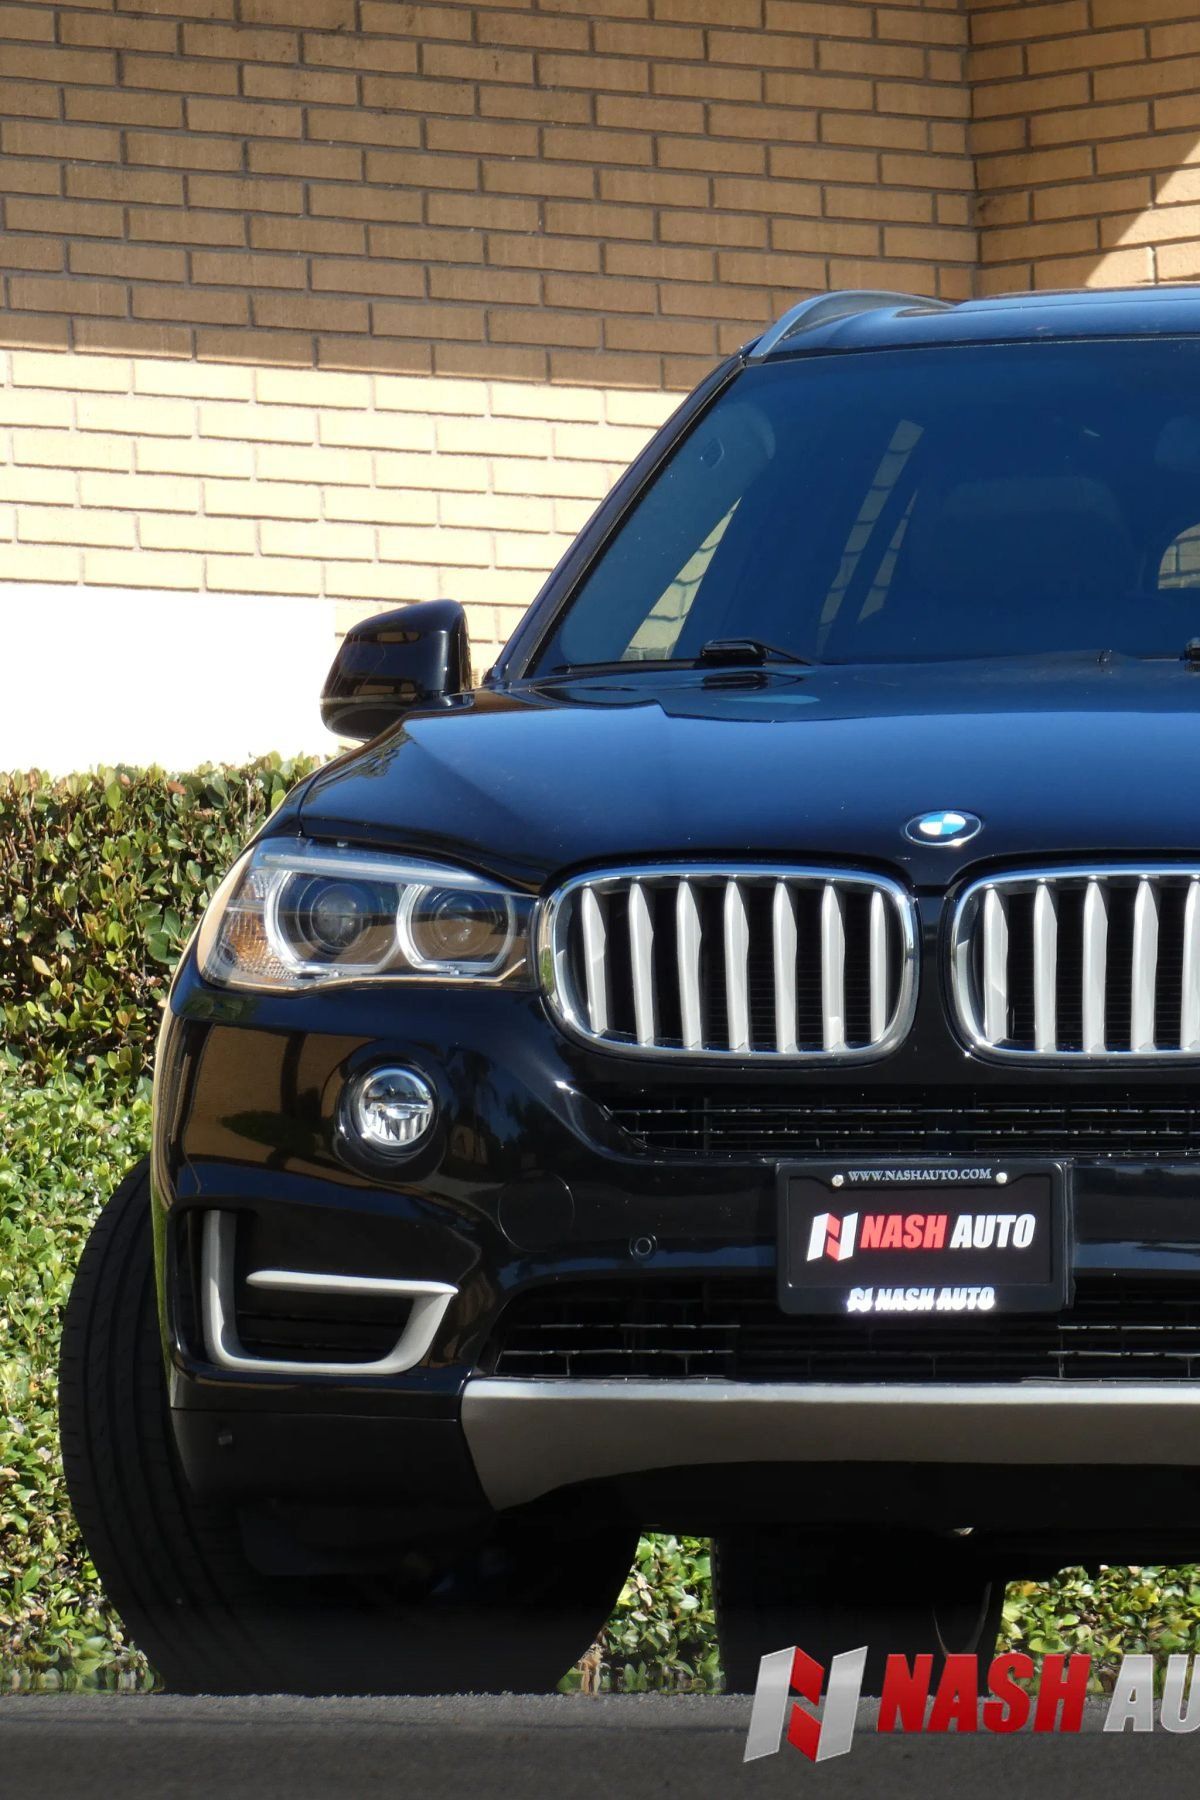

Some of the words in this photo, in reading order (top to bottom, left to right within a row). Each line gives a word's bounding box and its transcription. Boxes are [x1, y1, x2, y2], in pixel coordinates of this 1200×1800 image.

[847, 1168, 992, 1182] WWW.NASHAUTO.COM
[860, 1214, 948, 1249] NASH
[949, 1214, 1036, 1249] AUTO
[875, 1287, 936, 1311] NASH
[936, 1286, 996, 1311] AUTO
